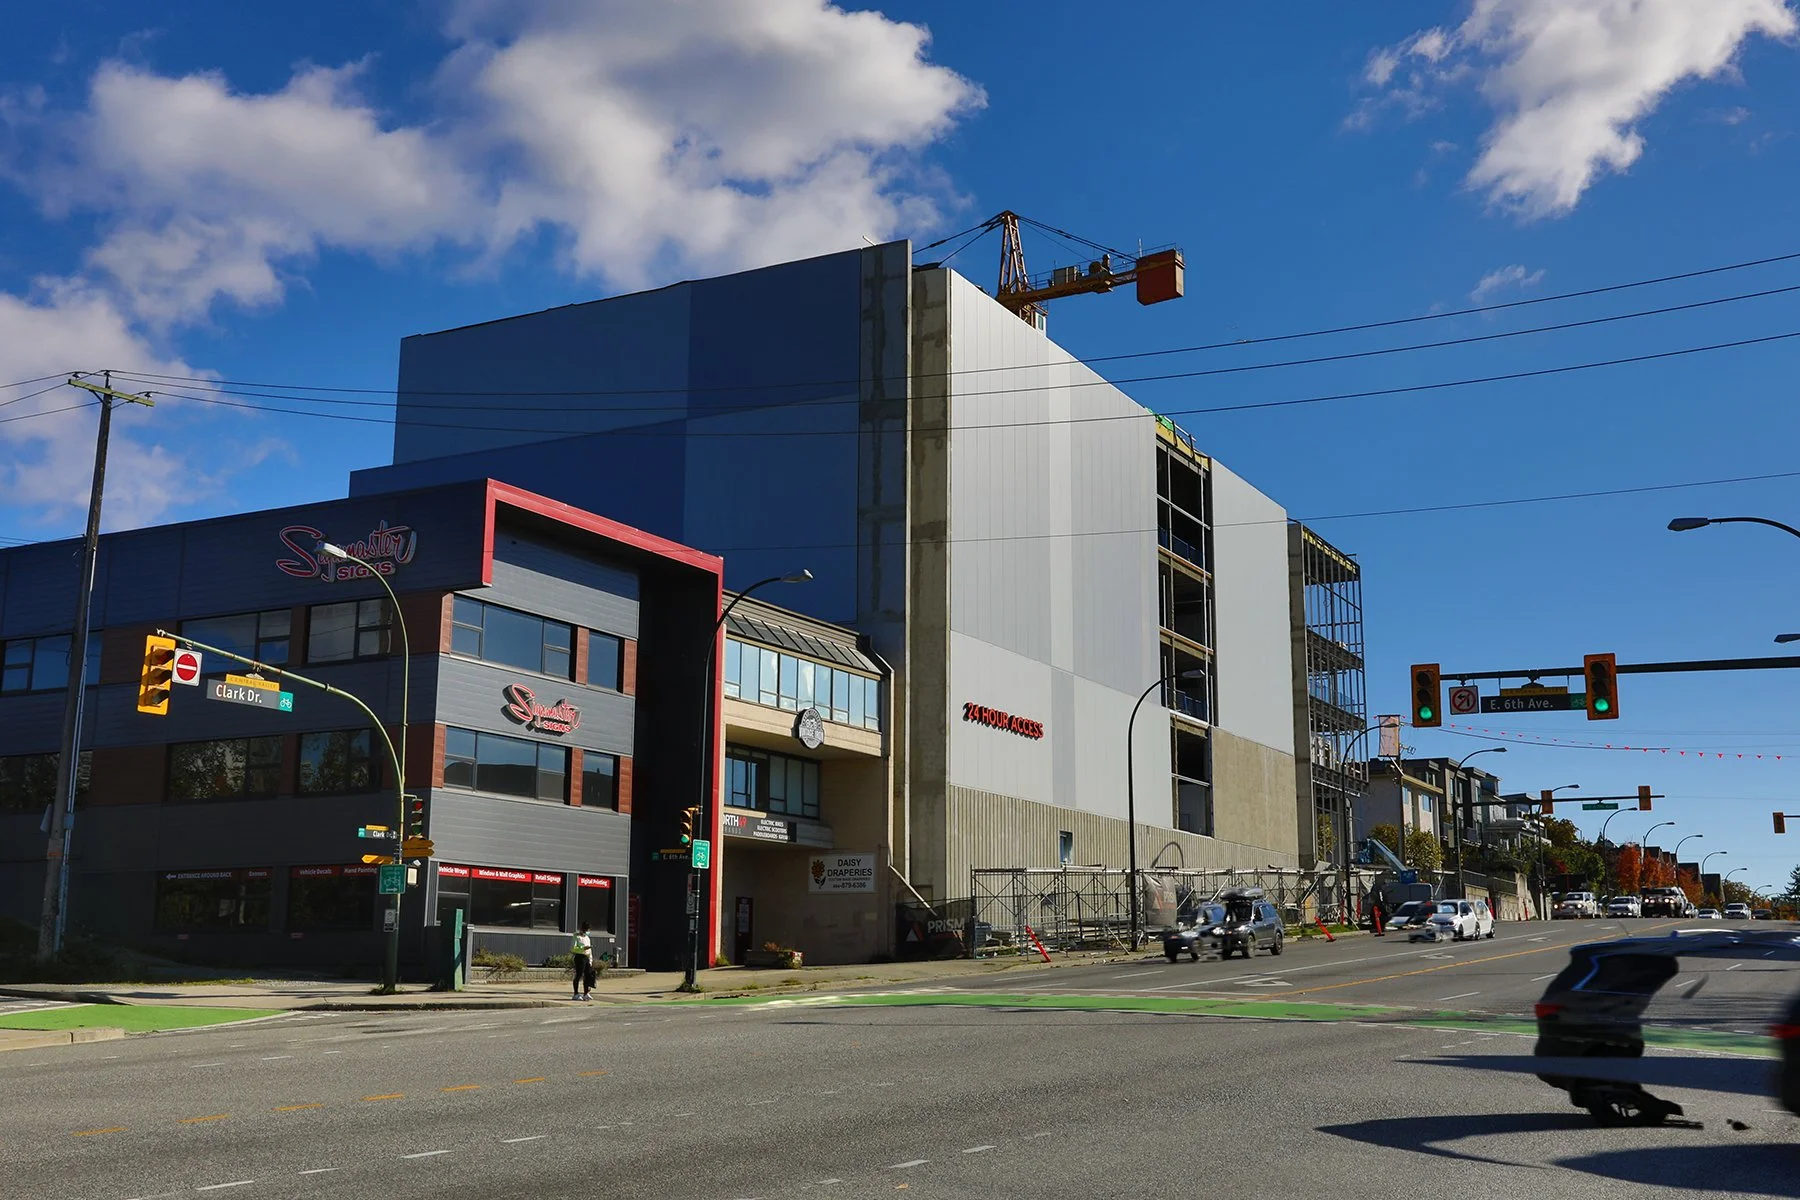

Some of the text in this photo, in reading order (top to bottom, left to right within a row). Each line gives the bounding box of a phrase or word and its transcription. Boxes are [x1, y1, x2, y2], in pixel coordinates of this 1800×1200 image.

[337, 562, 392, 580] SIGNS
[215, 684, 262, 704] Clark Dr.
[1490, 698, 1555, 710] E. 6th Ave.
[544, 721, 571, 733] SIGNS
[963, 702, 1044, 740] 24 HOUR ACCESS
[372, 830, 385, 838] Clark
[837, 858, 862, 867] DAISY
[827, 868, 873, 877] DRAPERIES
[927, 918, 965, 933] PRISM
